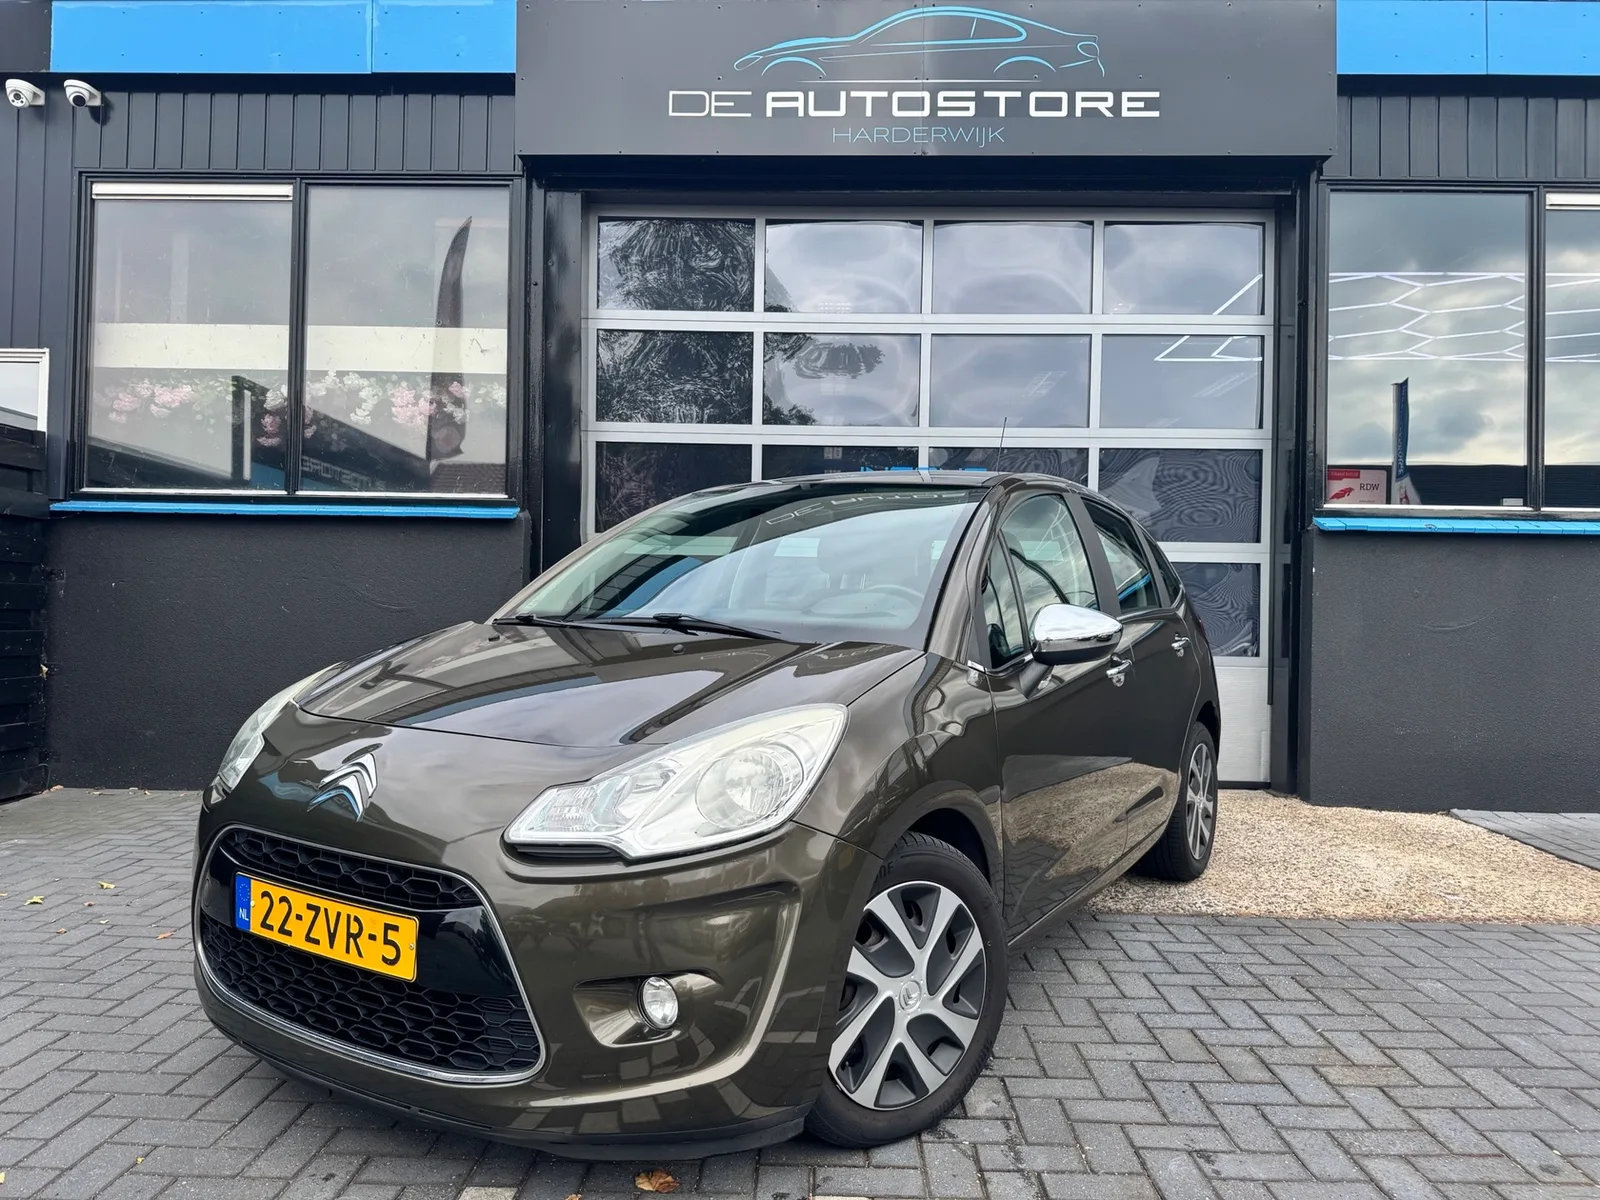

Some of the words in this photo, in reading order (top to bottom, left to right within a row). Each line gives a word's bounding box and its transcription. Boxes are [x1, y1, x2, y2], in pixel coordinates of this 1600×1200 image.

[668, 90, 753, 118] DE
[765, 90, 1161, 118] AUTOSTORE
[831, 126, 1006, 146] HARDERWIJK
[1359, 482, 1380, 491] RDW
[239, 907, 249, 921] NL
[260, 890, 401, 966] 22-ZVR-5
